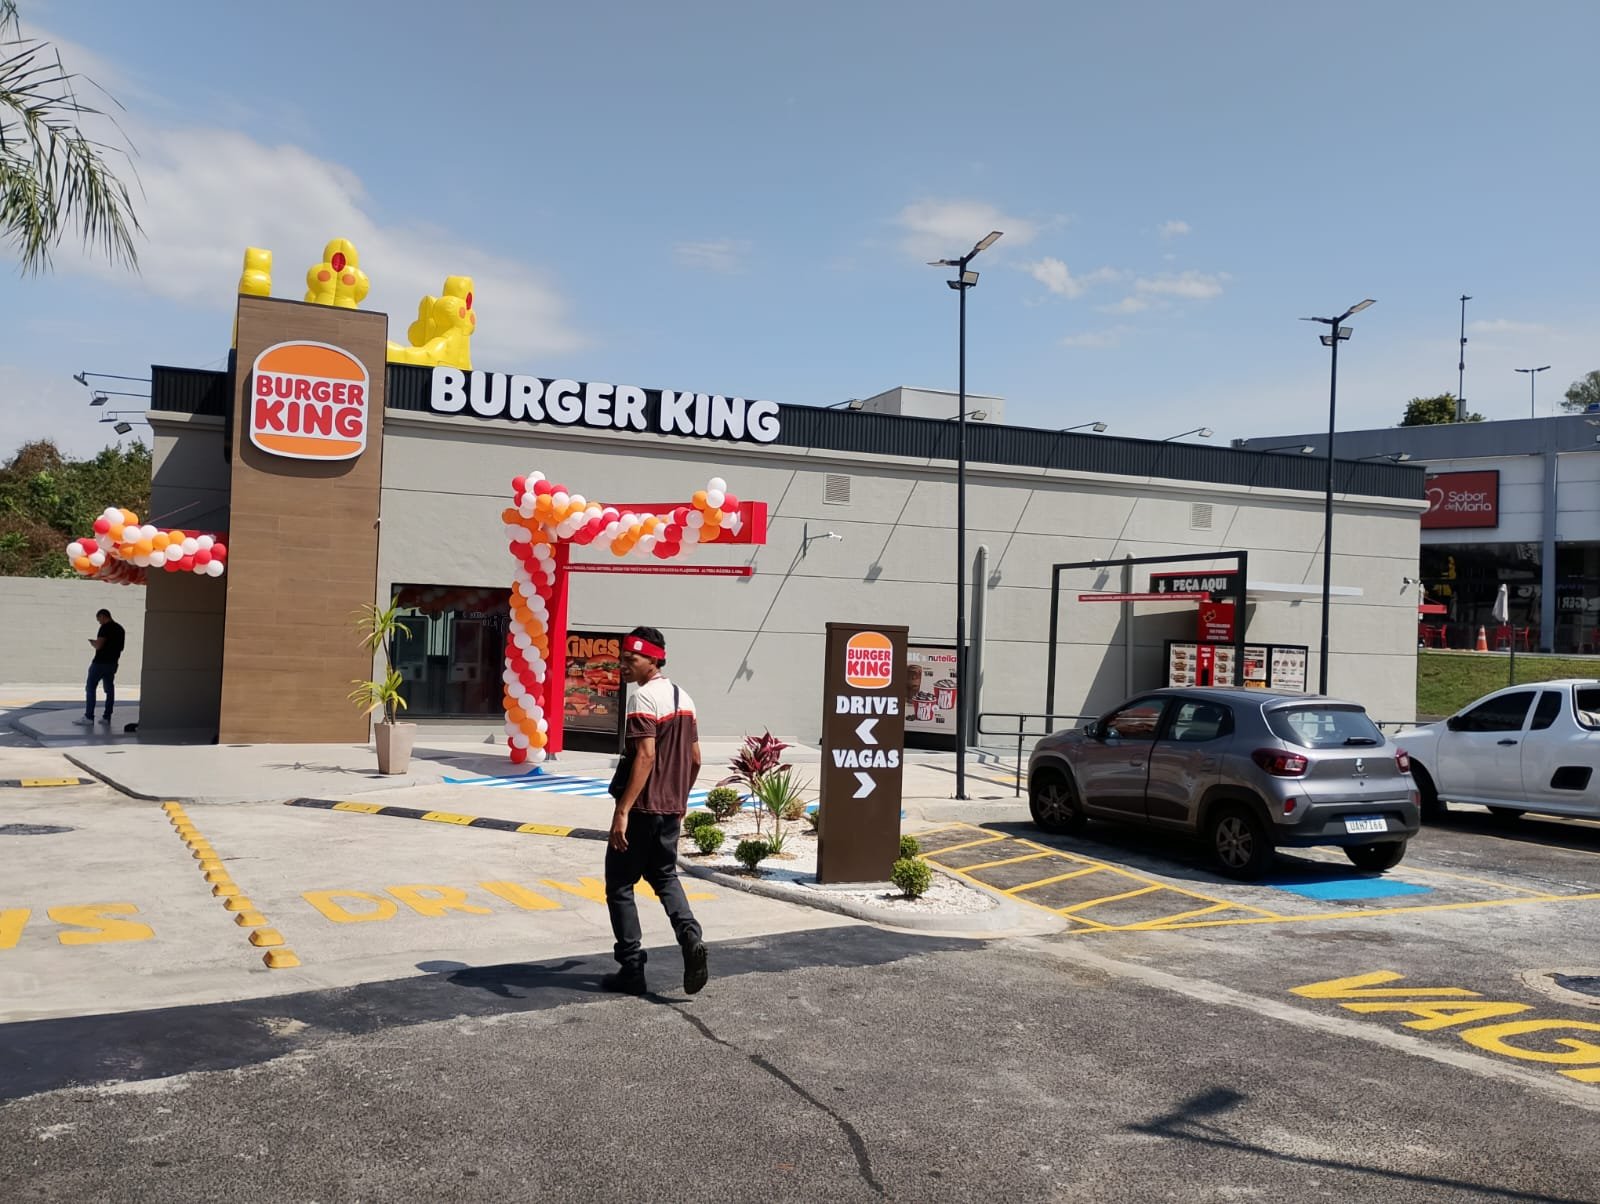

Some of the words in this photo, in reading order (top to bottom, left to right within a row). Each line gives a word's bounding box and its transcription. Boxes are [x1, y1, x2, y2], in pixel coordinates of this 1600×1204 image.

[255, 374, 364, 406] BURGER
[431, 366, 648, 431] BURGER
[659, 388, 782, 443] KING
[254, 397, 364, 439] KING
[1448, 490, 1487, 504] Sabor
[1455, 502, 1492, 513] Maria
[1172, 579, 1200, 593] PEÇA
[1201, 577, 1228, 592] AQUI
[847, 648, 892, 662] BURGER
[846, 661, 891, 678] KING
[836, 696, 898, 715] DRIVE
[832, 749, 900, 769] VAGAS
